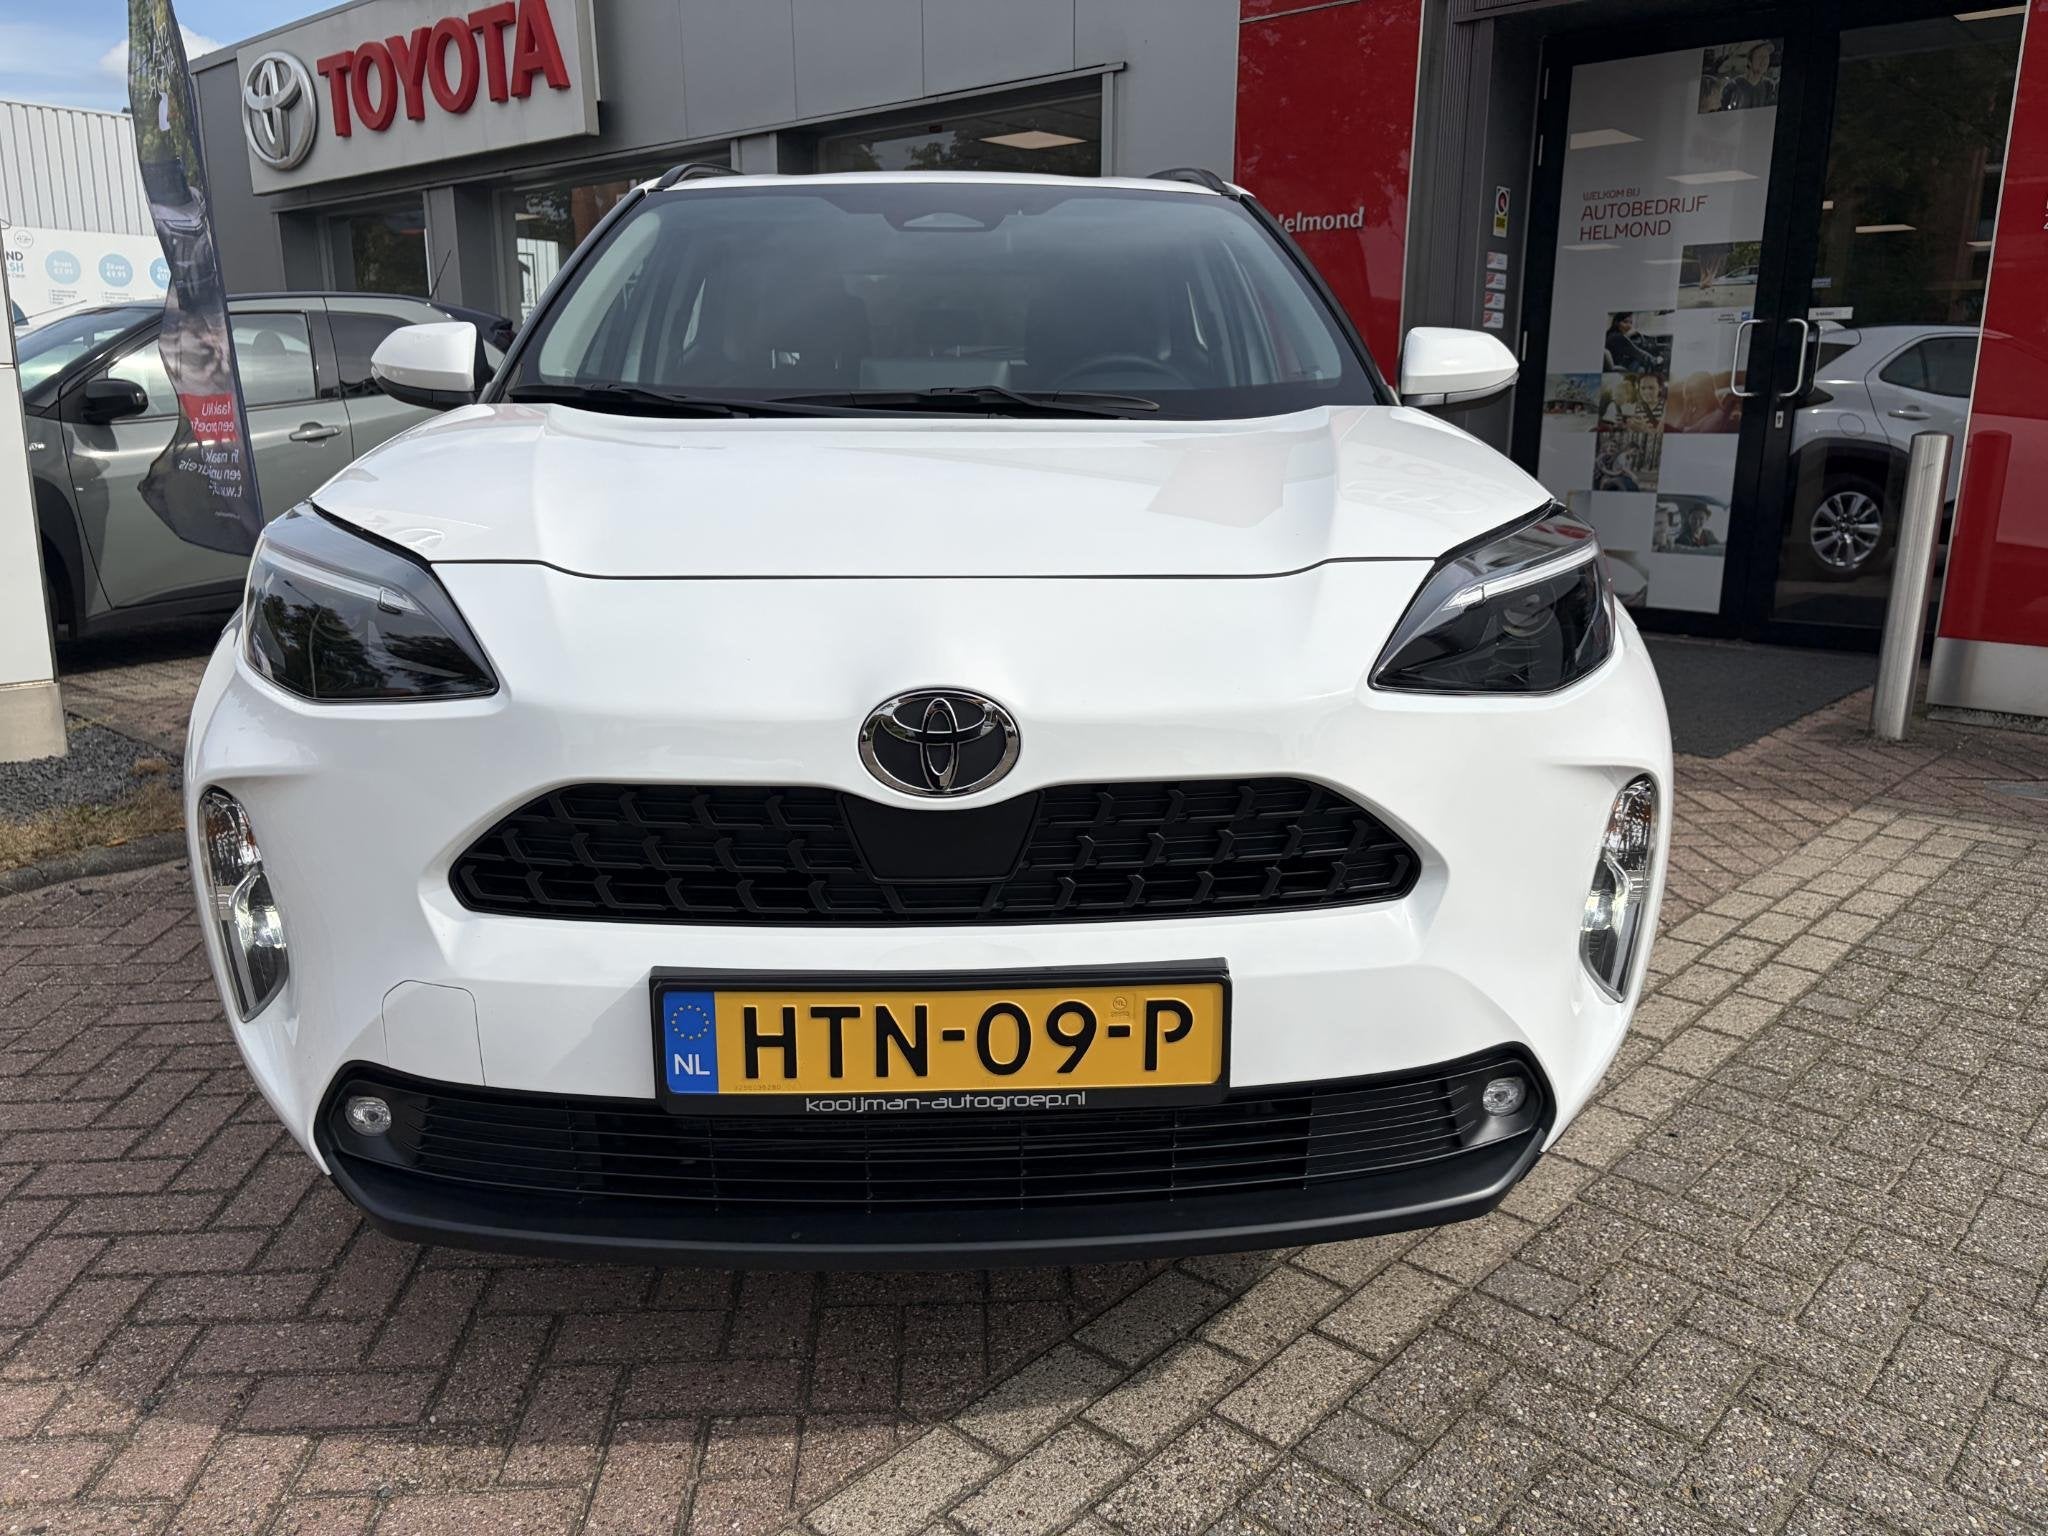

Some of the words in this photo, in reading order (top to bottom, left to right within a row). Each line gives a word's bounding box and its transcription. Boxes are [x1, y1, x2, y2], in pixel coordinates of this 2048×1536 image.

[317, 0, 571, 137] TOYOTA
[1583, 189, 1622, 201] WELKOM
[1626, 188, 1640, 198] BIJ
[1581, 195, 1708, 221] AUTOBEDRIJF
[1579, 219, 1671, 242] HELMOND
[743, 998, 1194, 1078] HTN-09-P
[674, 1053, 711, 1076] NL
[805, 1090, 1087, 1113] kooijman-autogroep.nl
